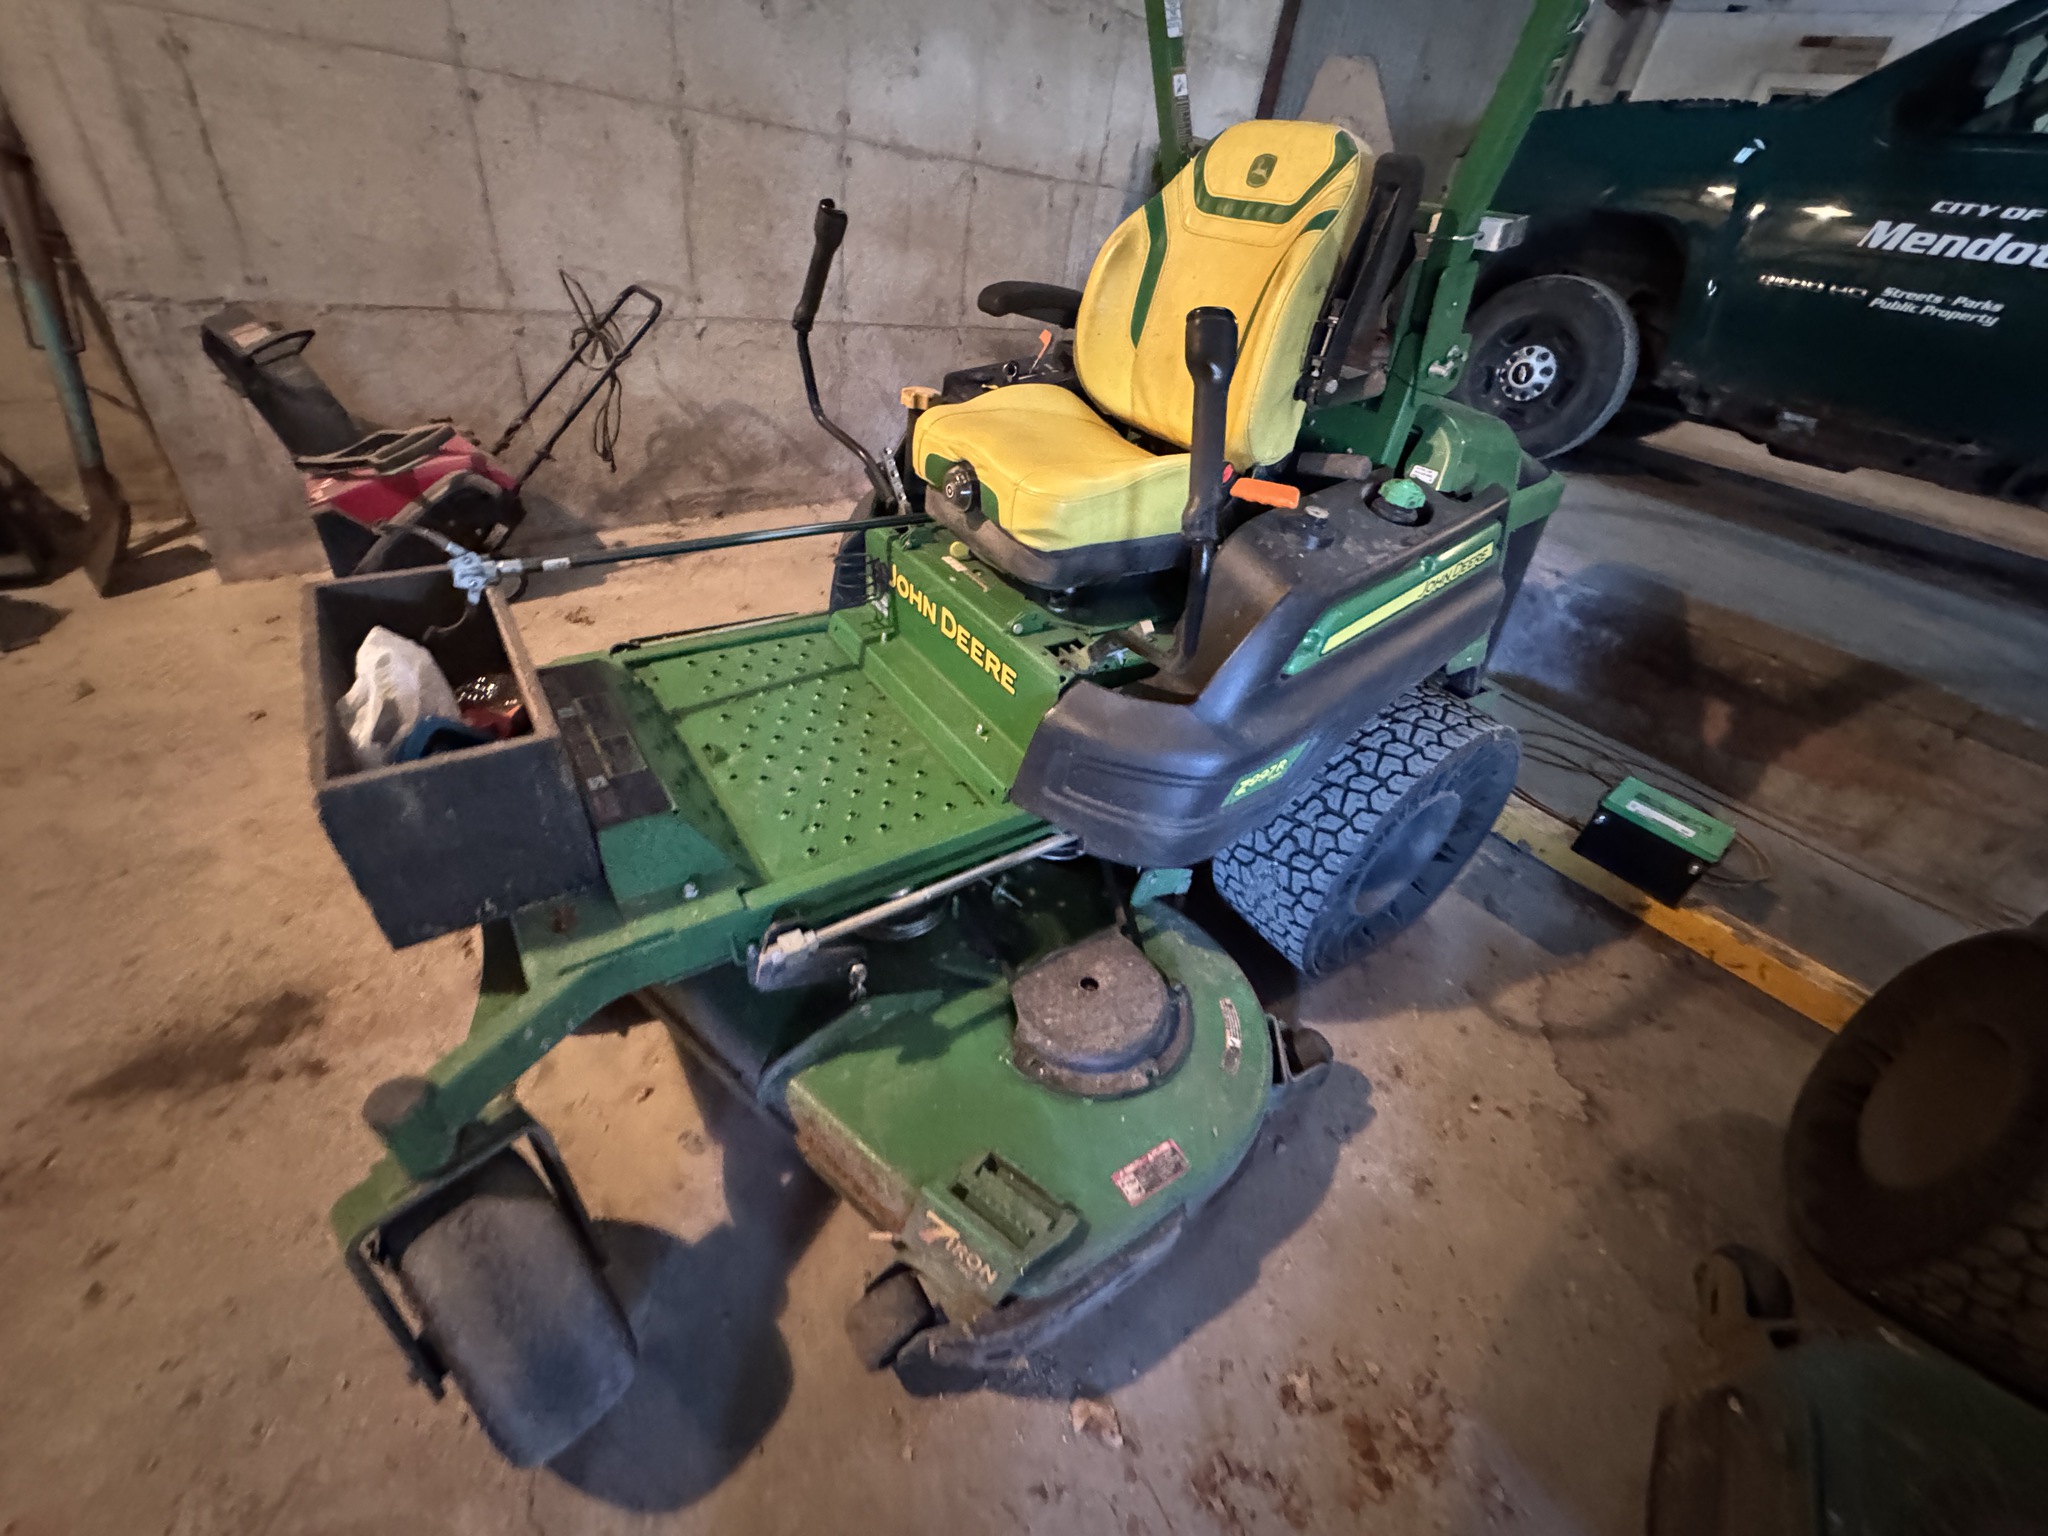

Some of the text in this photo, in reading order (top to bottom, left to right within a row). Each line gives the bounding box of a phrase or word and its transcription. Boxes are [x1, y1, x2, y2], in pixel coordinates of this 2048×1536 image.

[1930, 200, 2047, 221] CITY OF
[1868, 297, 2000, 328] Public Property
[1880, 286, 1945, 304] Streets
[1950, 296, 2005, 313] Parks
[1417, 548, 1489, 598] JOHN DEERE
[888, 563, 1017, 695] JOHN DEERE
